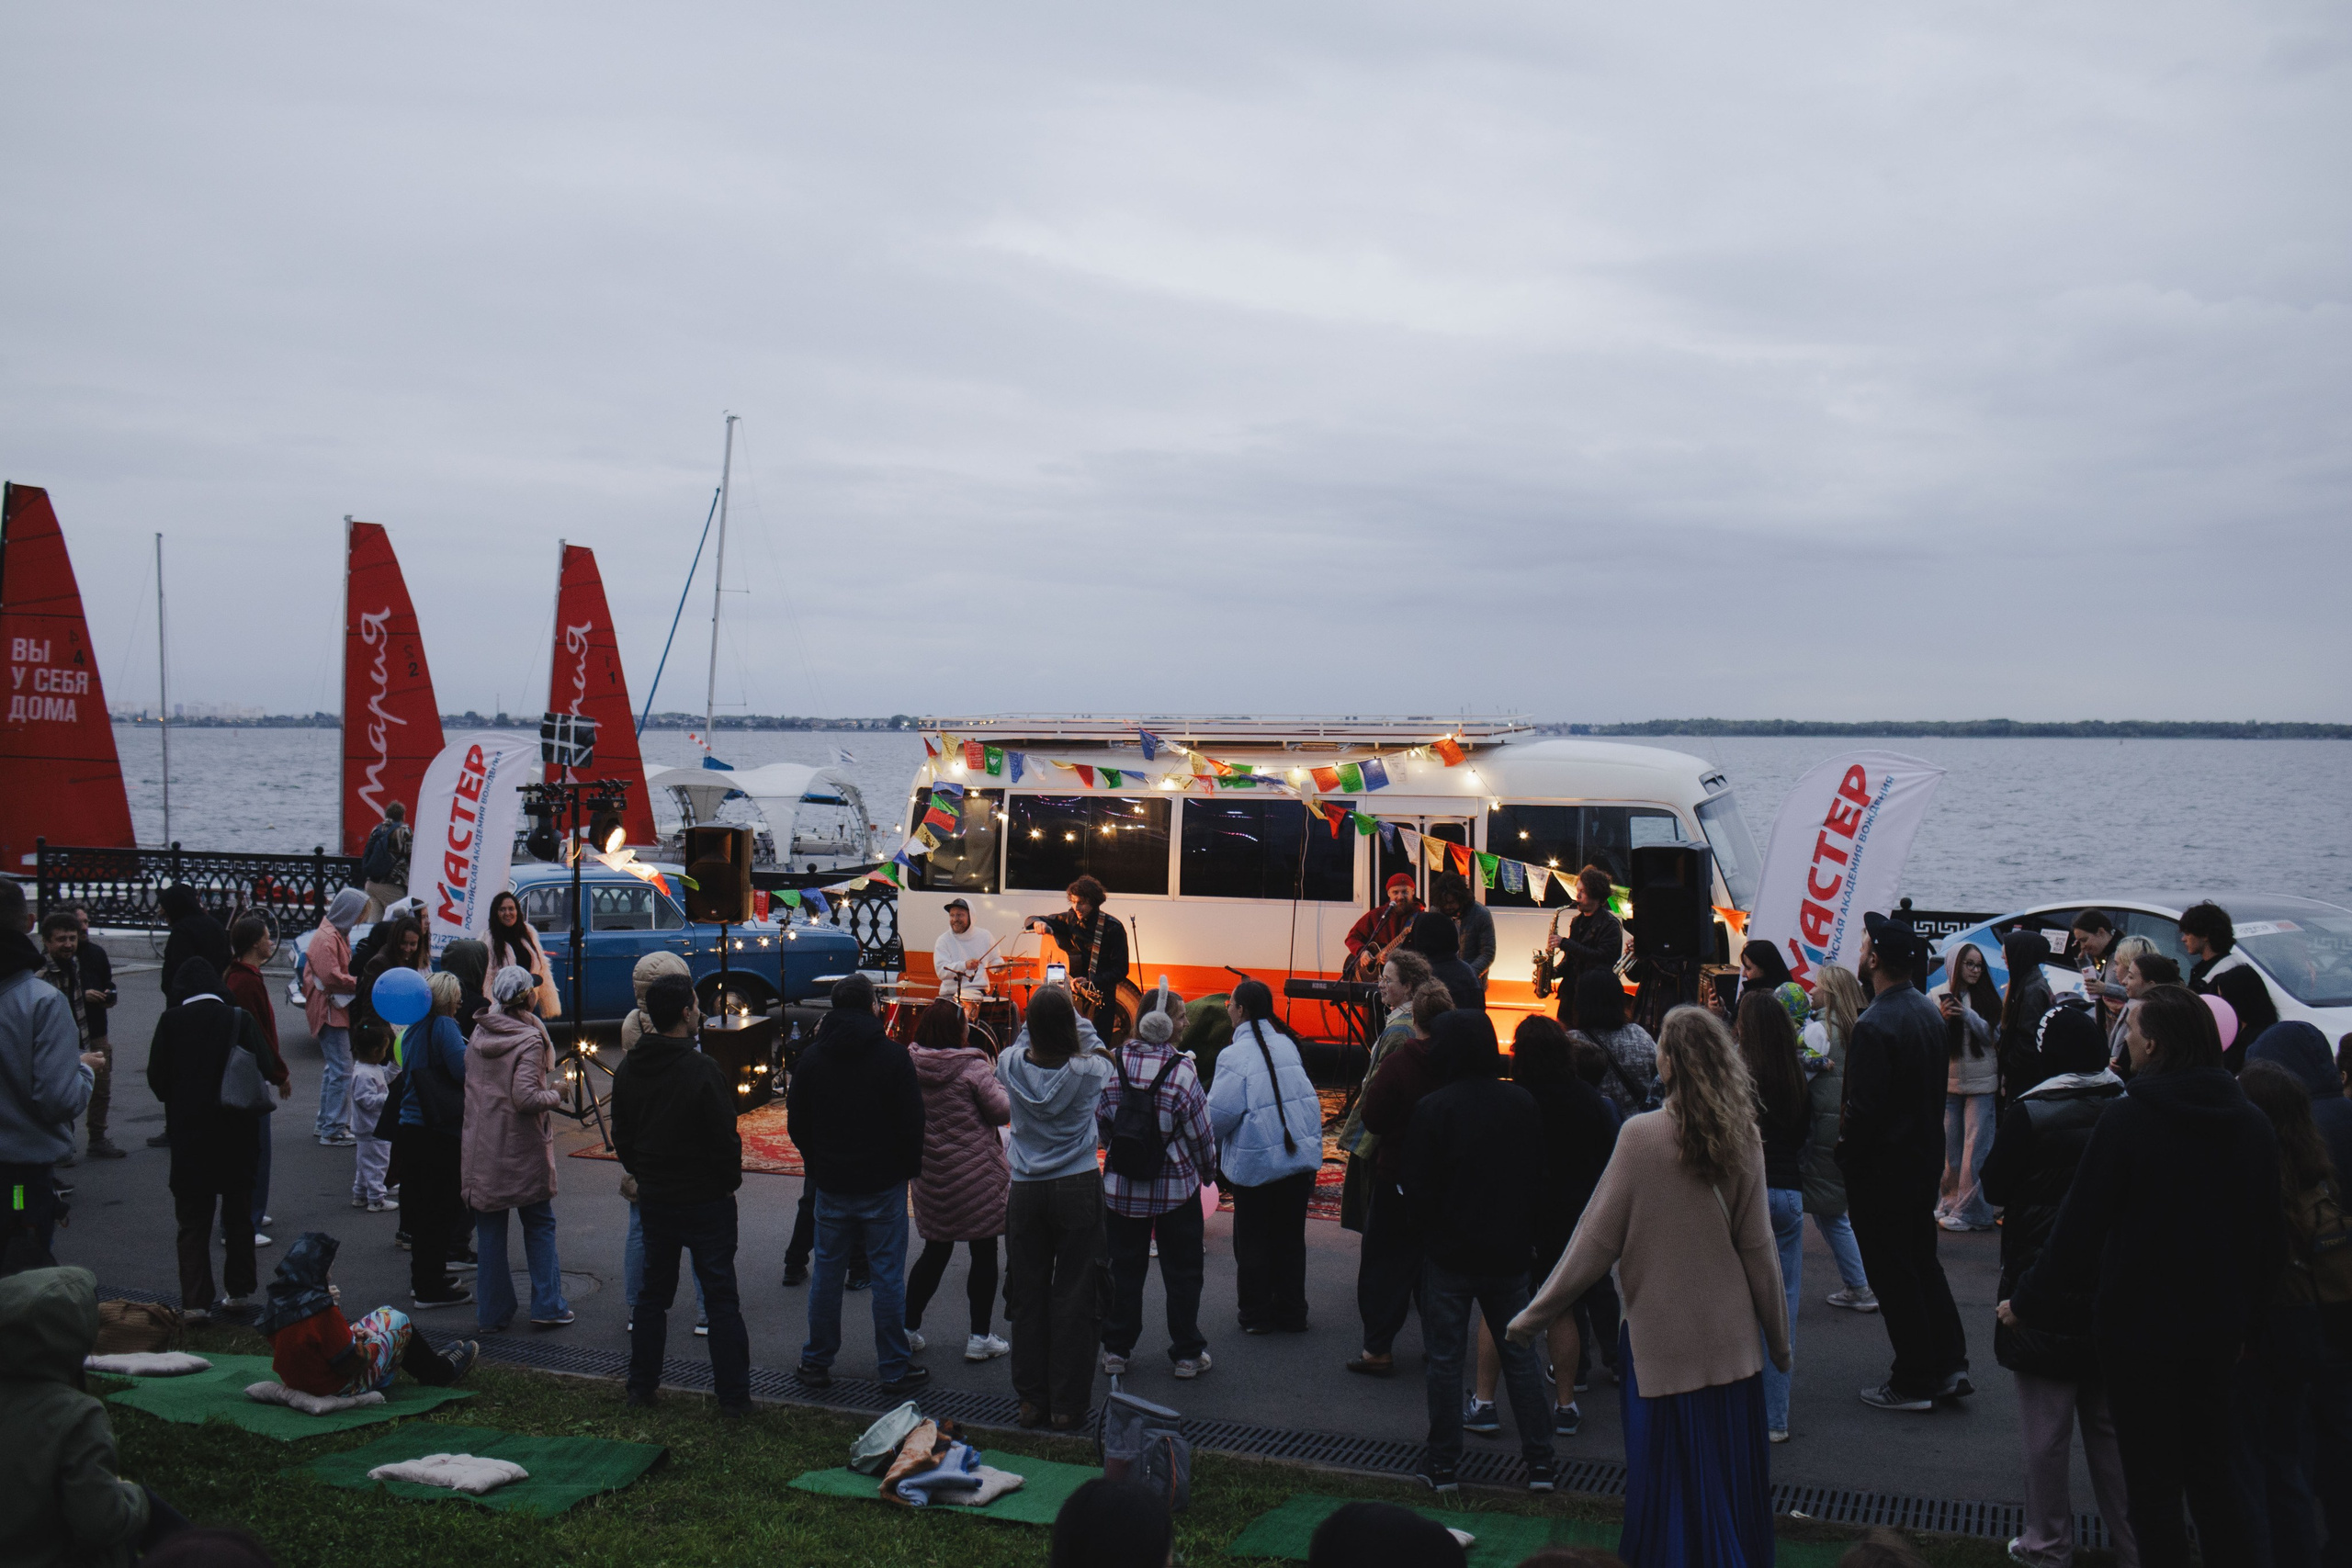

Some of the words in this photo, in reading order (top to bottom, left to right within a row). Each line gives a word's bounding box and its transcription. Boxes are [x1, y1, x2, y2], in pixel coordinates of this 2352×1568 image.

[12, 637, 51, 663] ВЫ
[74, 649, 85, 666] 4
[11, 667, 27, 690] У
[34, 668, 89, 695] СЕБЯ
[409, 662, 419, 678] 2
[608, 671, 616, 685] 1
[7, 695, 77, 724] ДОМА
[437, 744, 487, 927] МАСТЕР
[465, 863, 479, 931] РОССИЙСКАЯ
[472, 806, 486, 863] АКАДЕМИЯ
[481, 750, 503, 805] ВОЖДЕНИЯ
[1840, 844, 1864, 917] АКАДЕМИЯ
[1859, 775, 1894, 842] ВОЖДЕНИЯ
